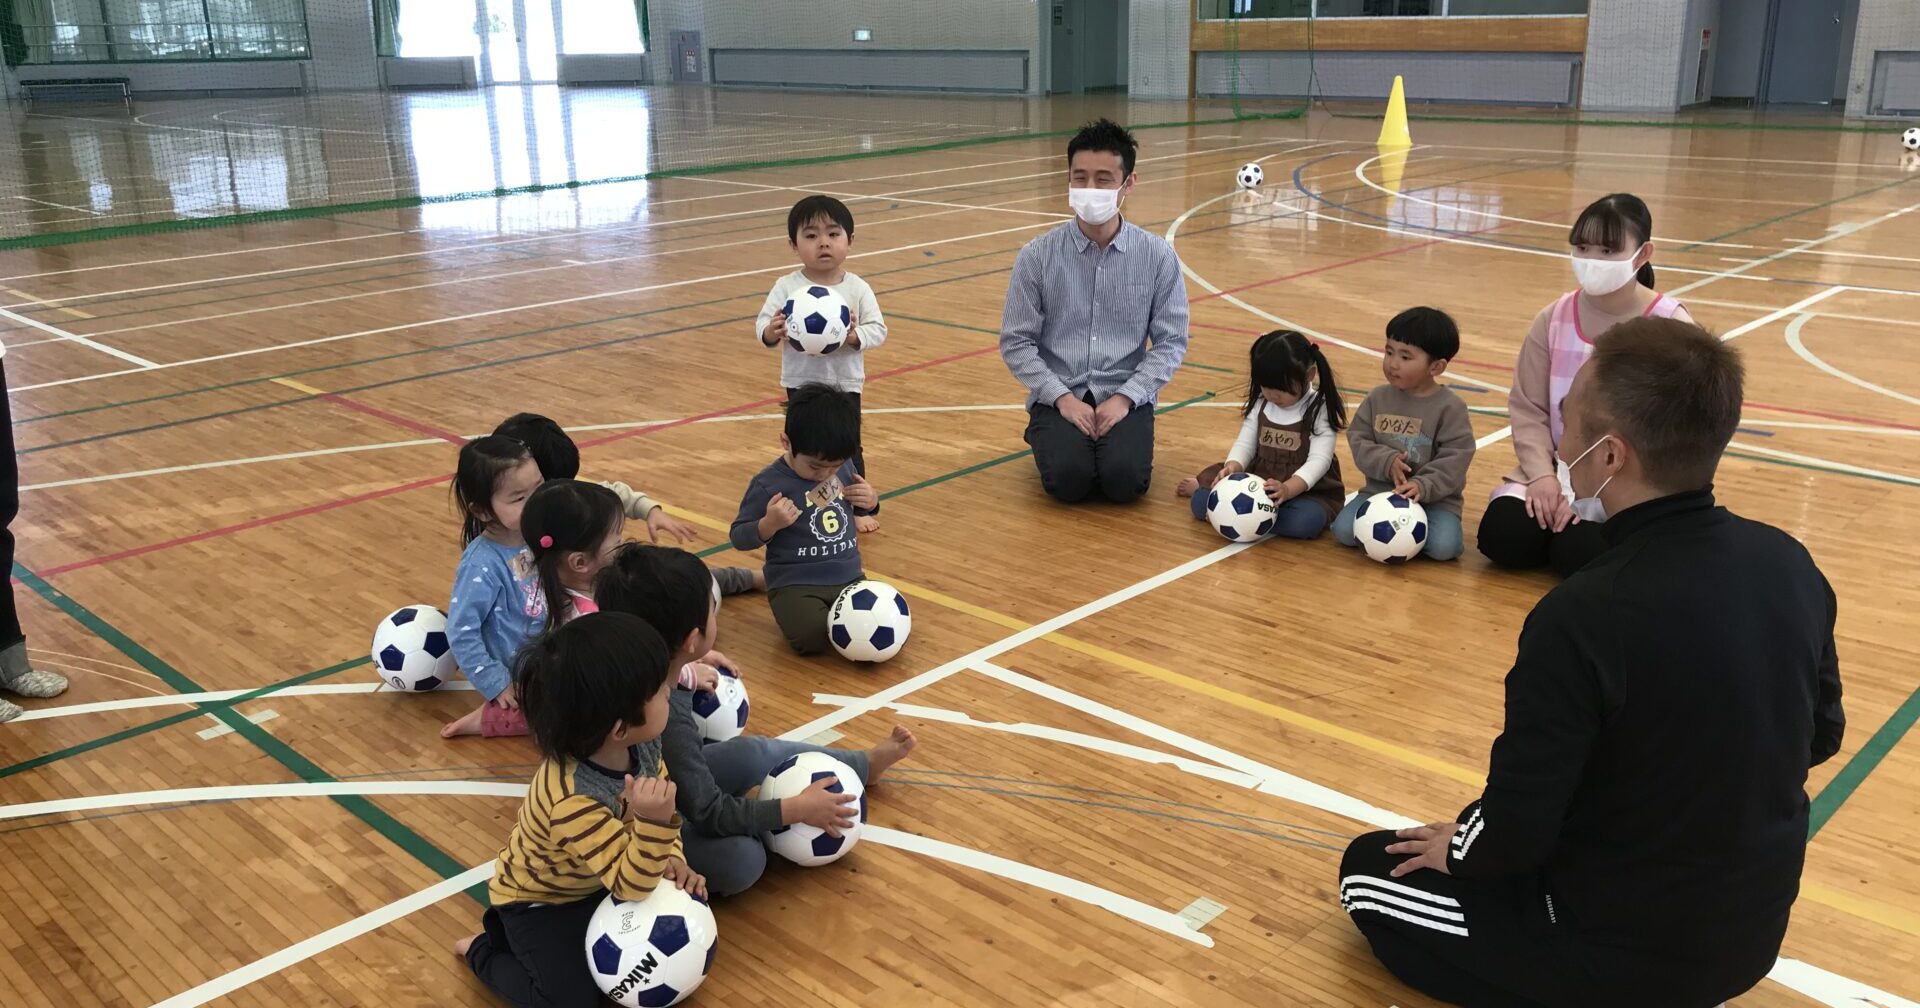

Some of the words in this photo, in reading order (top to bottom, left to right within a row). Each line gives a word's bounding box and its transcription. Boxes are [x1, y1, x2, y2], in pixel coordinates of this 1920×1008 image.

[1380, 417, 1415, 435] かなた
[1262, 429, 1294, 447] あやの
[822, 510, 840, 534] 6
[797, 537, 858, 556] HOLIDAY
